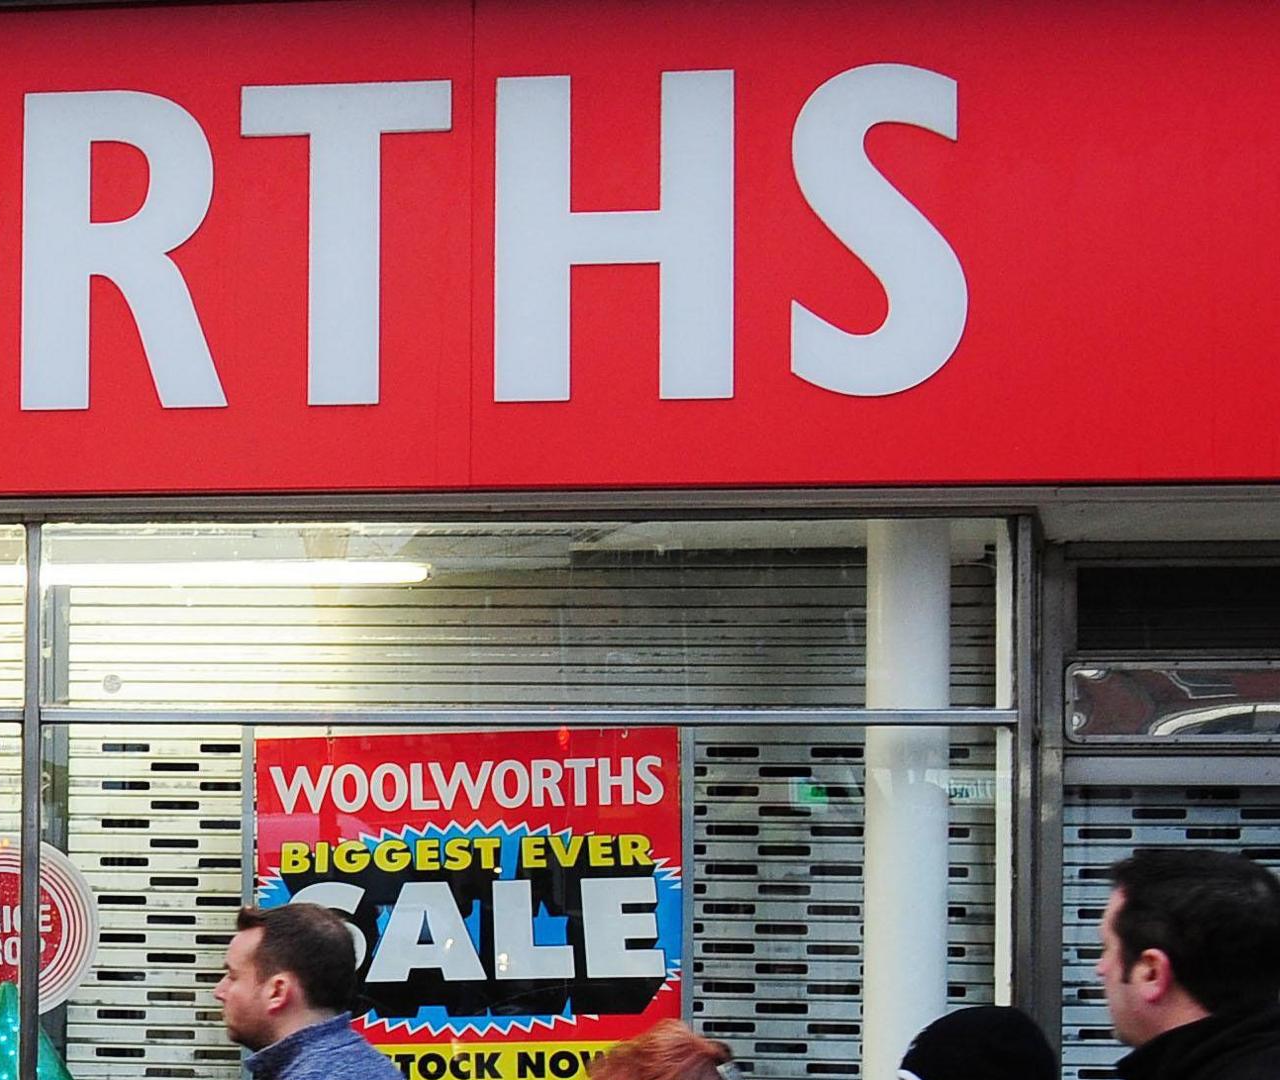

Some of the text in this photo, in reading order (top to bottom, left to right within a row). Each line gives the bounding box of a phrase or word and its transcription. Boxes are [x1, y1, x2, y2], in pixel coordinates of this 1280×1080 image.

[269, 755, 665, 815] WOOLWORTHS
[280, 834, 654, 875] BIGGEST EVER
